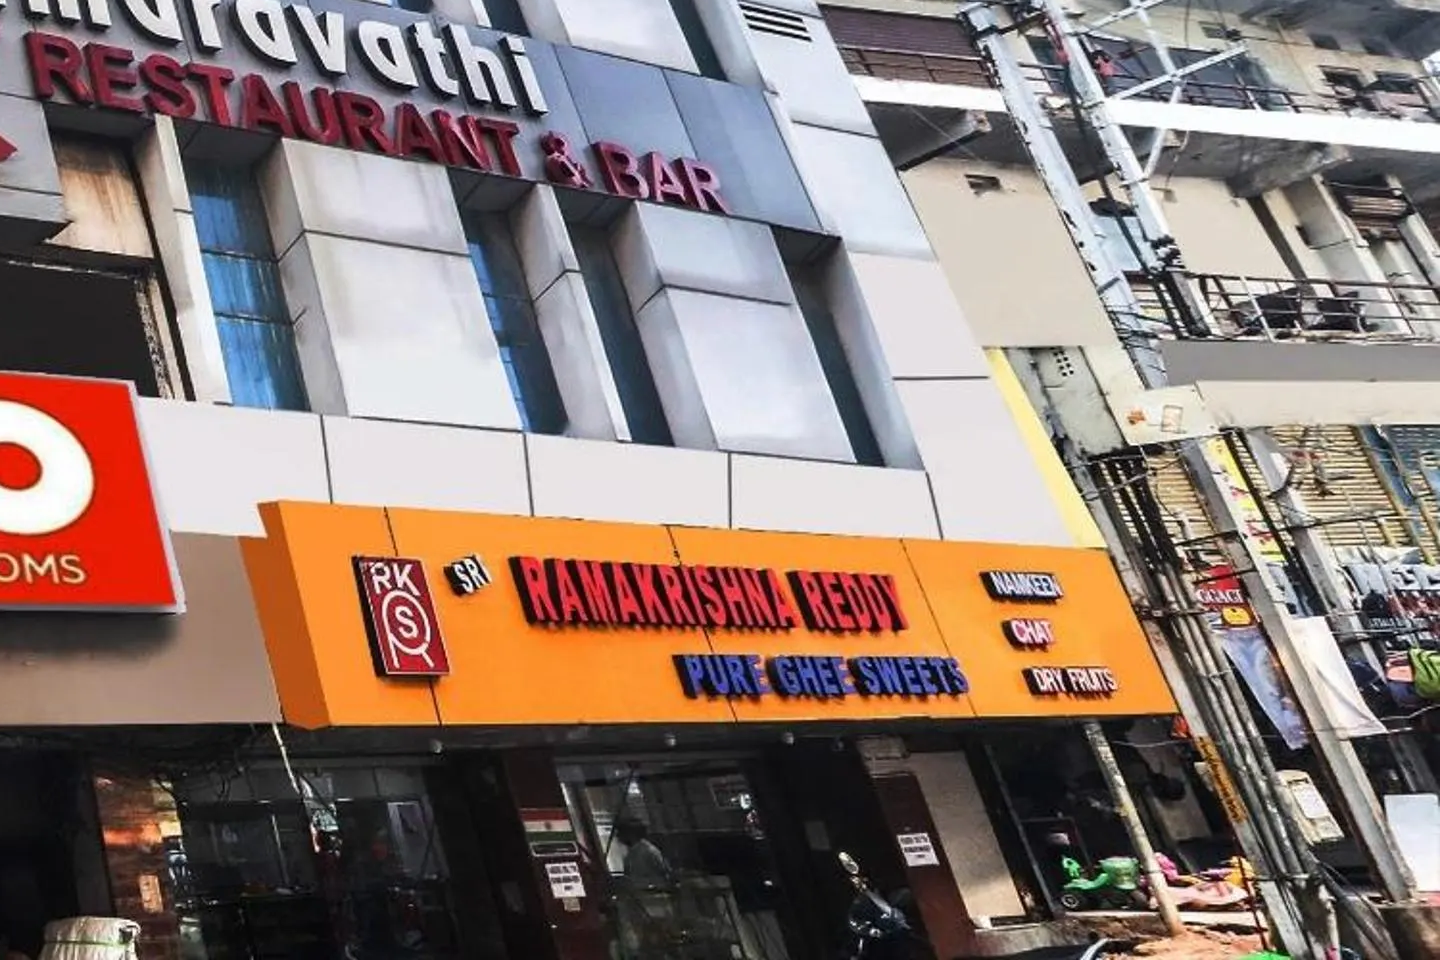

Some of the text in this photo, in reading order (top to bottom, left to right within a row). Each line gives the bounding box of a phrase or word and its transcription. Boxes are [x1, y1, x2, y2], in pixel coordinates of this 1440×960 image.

[23, 29, 525, 178] RESTAURANT
[539, 130, 593, 190] &
[591, 140, 730, 215] BAR
[369, 561, 421, 596] RK
[449, 554, 909, 631] SRI RAMAKRISHNA REDDY
[985, 571, 1064, 598] NAMKEEN
[1007, 618, 1055, 645] CHAT
[678, 654, 969, 698] PURE GHEE SWEETS
[1028, 667, 1118, 693] DRY FRUITS
